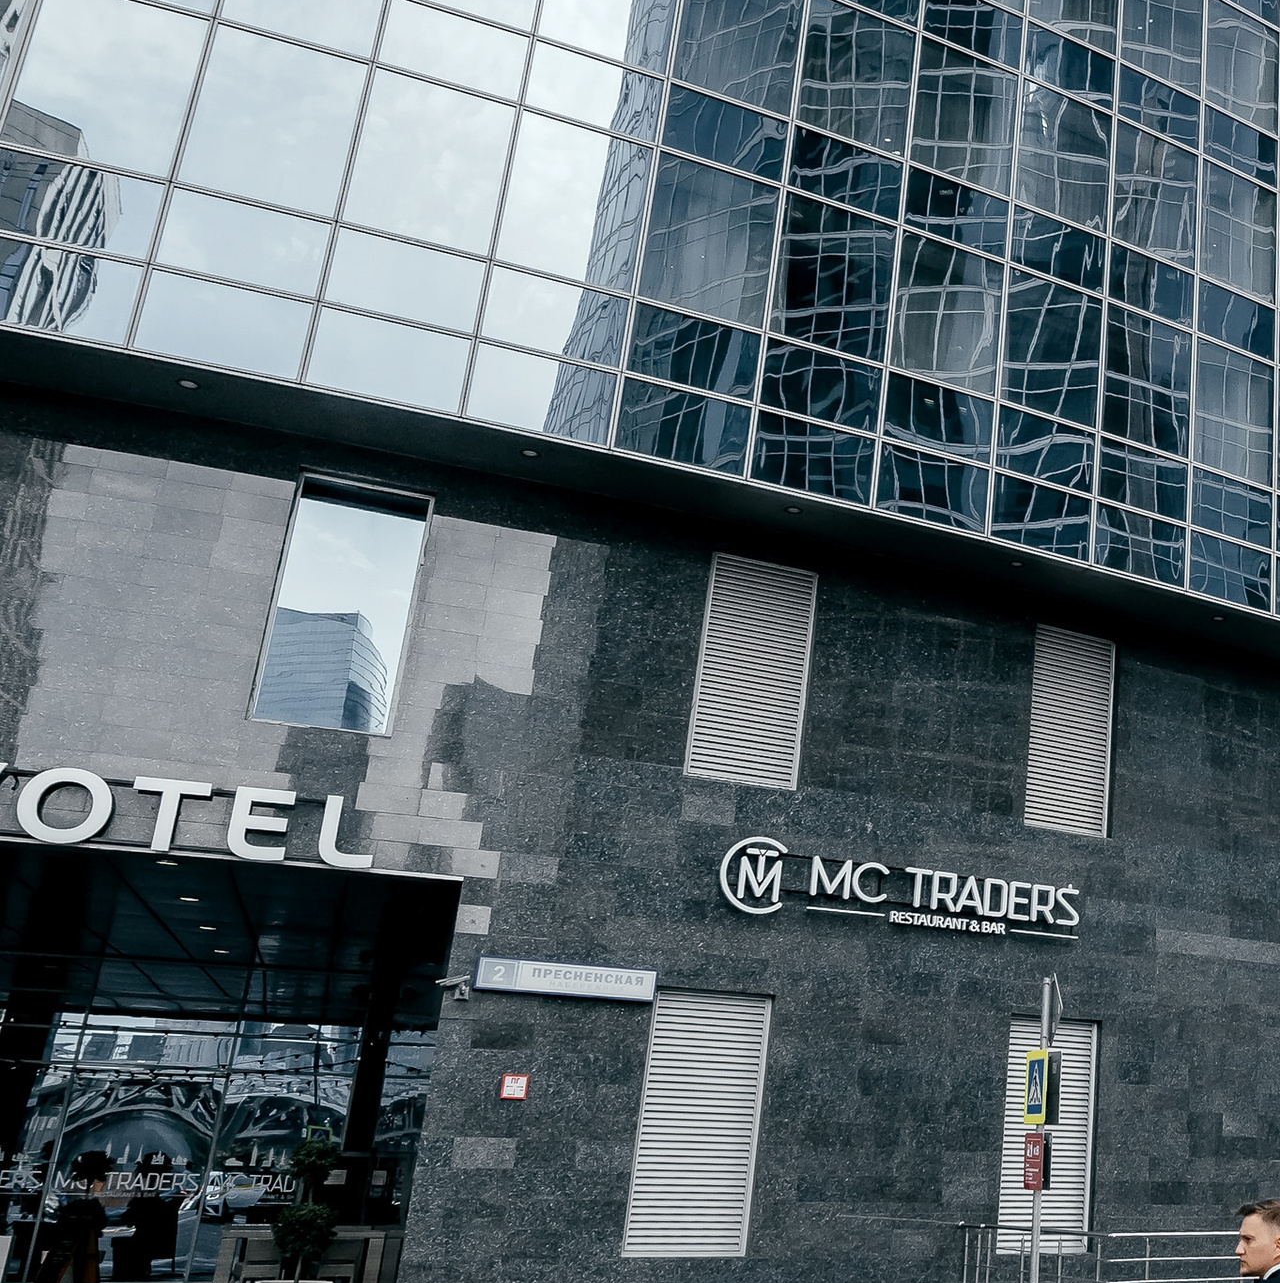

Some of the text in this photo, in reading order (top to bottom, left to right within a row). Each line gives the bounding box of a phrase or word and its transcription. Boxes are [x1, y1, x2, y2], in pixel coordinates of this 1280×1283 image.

[0, 762, 373, 868] OTEL
[811, 855, 1080, 927] MC TRADERS
[889, 910, 1006, 935] RESTAURANT & BAR
[492, 965, 644, 986] 2 ПРЕСНЕНСКАЯ
[105, 1171, 201, 1191] TRADERS
